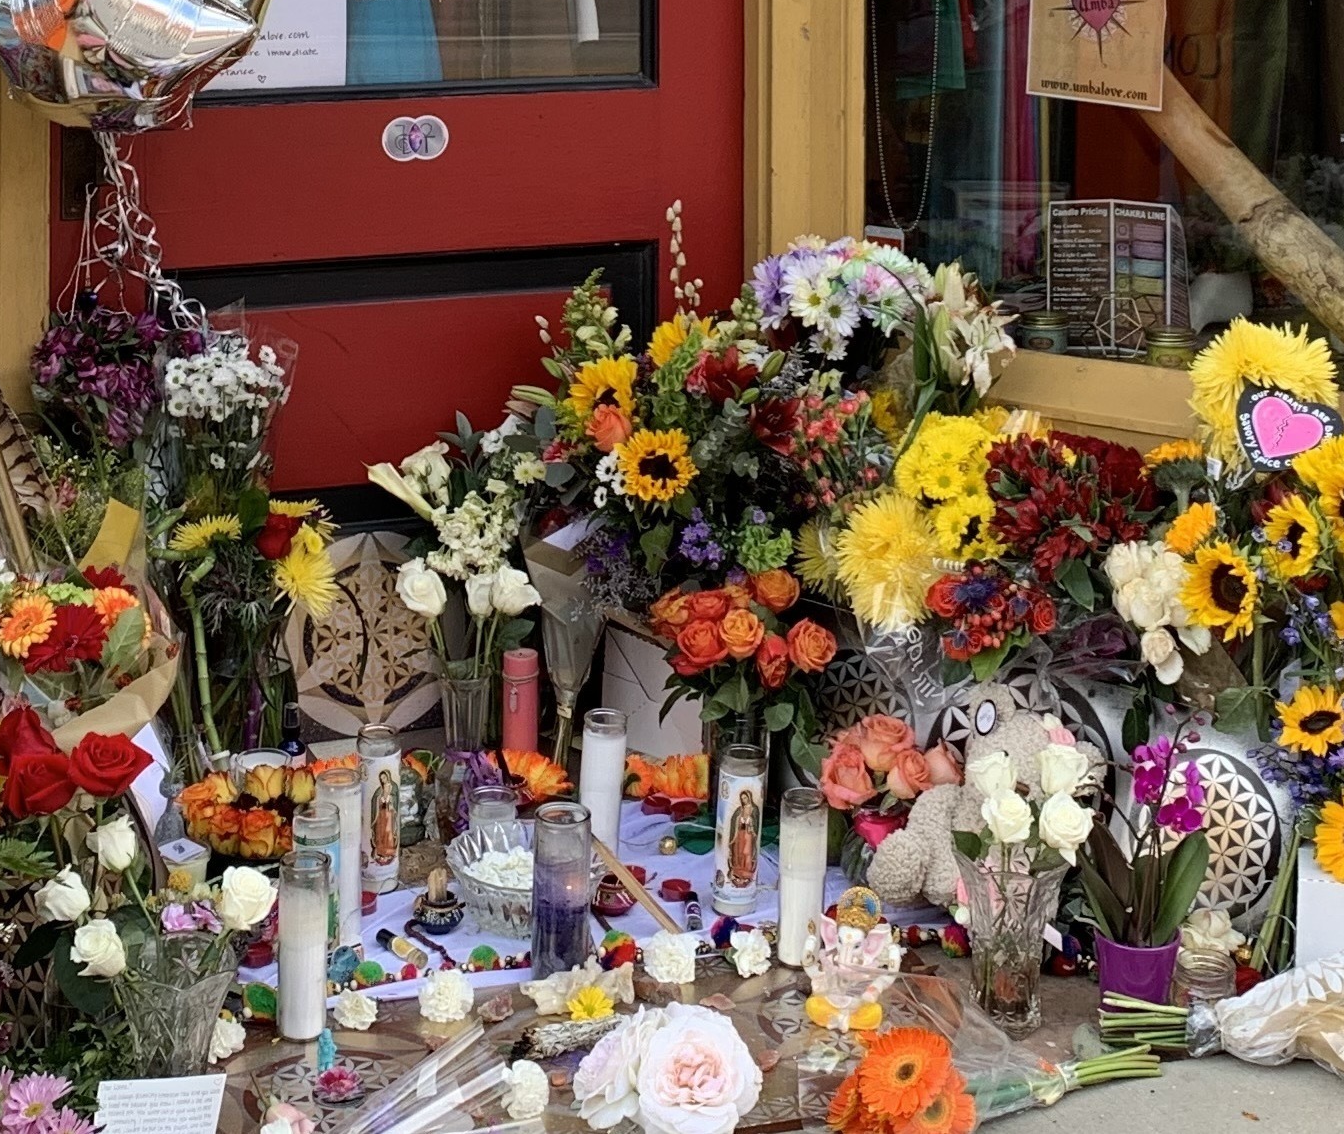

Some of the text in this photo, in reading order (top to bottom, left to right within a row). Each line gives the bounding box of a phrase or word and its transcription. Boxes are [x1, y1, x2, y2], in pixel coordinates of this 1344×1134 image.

[267, 48, 319, 57] immediate
[1041, 79, 1148, 101] www.umbalove.com
[1081, 208, 1108, 217] Pricing
[1115, 208, 1146, 219] CHAKRA
